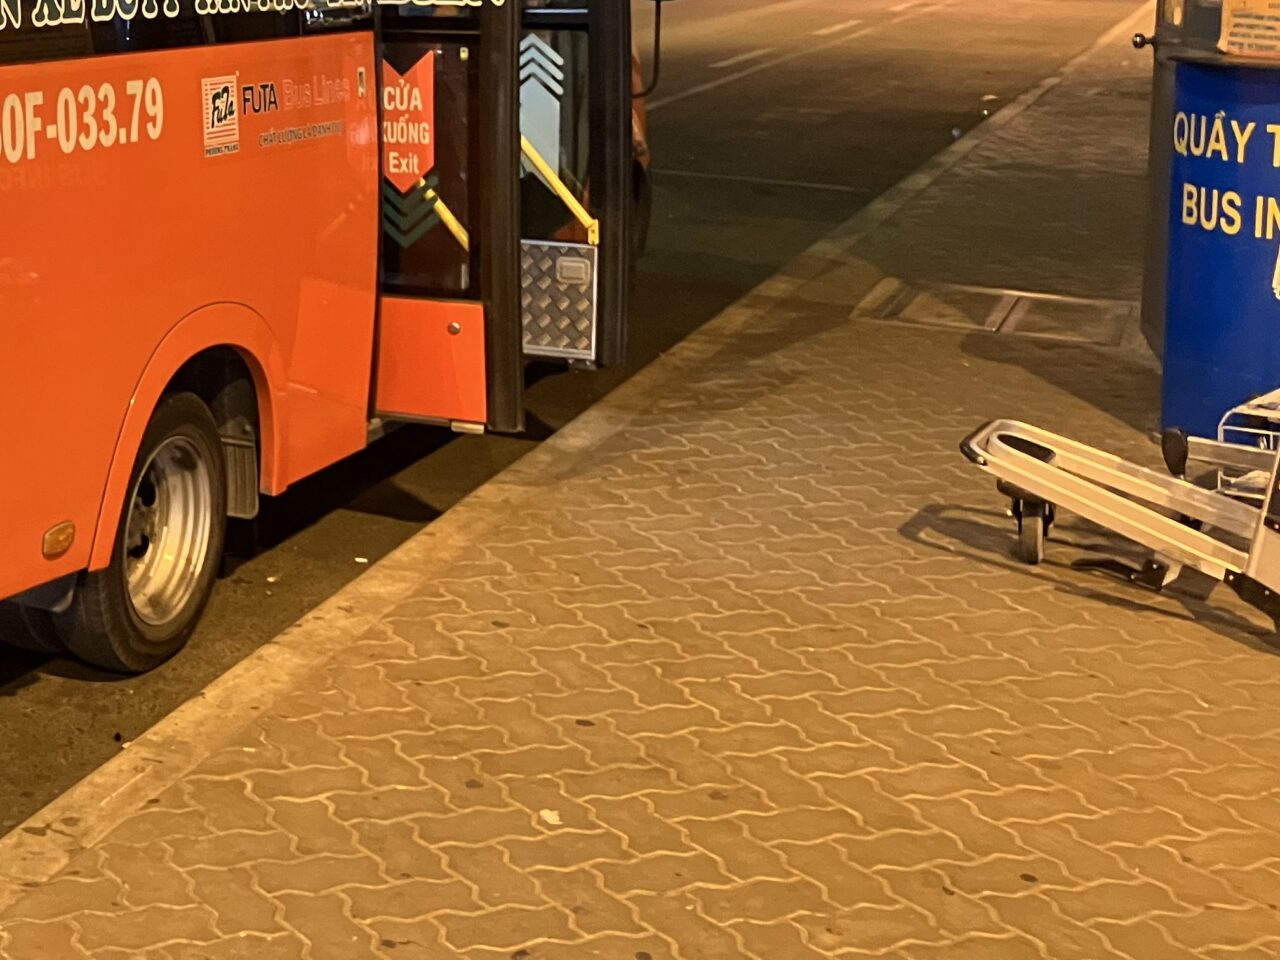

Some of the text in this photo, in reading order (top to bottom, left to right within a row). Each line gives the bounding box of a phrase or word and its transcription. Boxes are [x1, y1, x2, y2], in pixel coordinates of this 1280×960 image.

[241, 82, 279, 116] FUTA
[383, 79, 422, 111] CỬA
[1173, 110, 1256, 163] QUẦY
[388, 151, 419, 174] Exit
[1182, 182, 1241, 234] BUS
